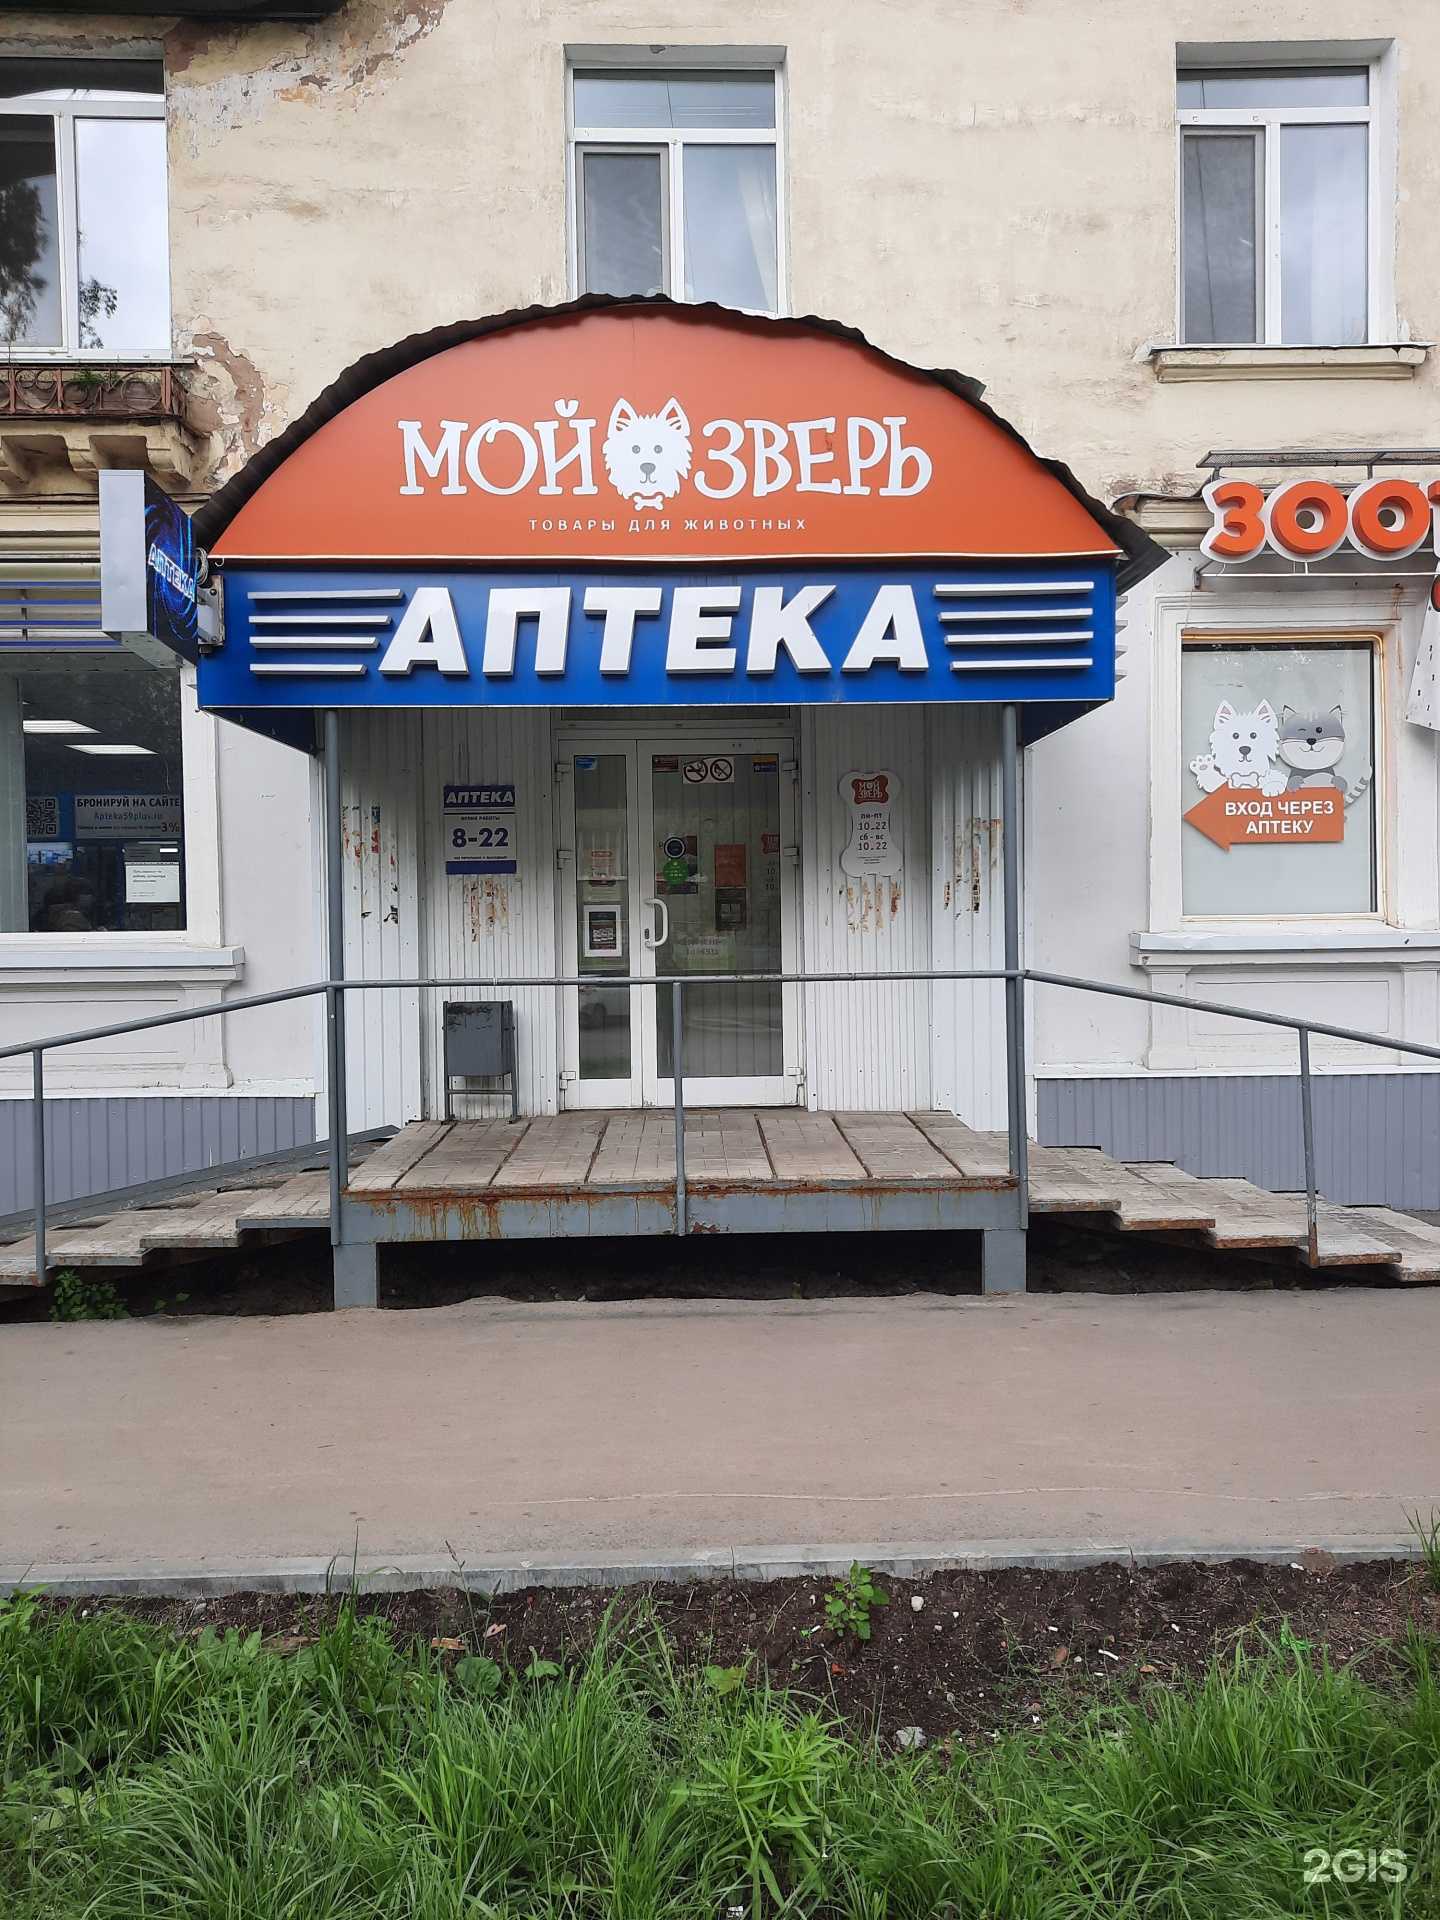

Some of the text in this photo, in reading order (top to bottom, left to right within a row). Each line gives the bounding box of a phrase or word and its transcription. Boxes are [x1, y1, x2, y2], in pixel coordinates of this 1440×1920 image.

[398, 399, 933, 499] МОЙ ЗВЕРЬ
[528, 518, 807, 533] ТОВАРЫ ДЛЯ ЖИВОТНЫХ
[1209, 479, 1440, 556] ЗОО
[148, 543, 196, 603] АПТЕКА
[378, 584, 930, 676] АПТЕКА
[77, 795, 180, 807] БРОНИРУЙ НА САЙТЕ
[446, 791, 513, 803] АПТЕКА
[1225, 800, 1335, 817] ВХОД ЧЕРЕЗ
[1245, 820, 1314, 834] АПТЕКУ
[452, 828, 508, 847] 8-22
